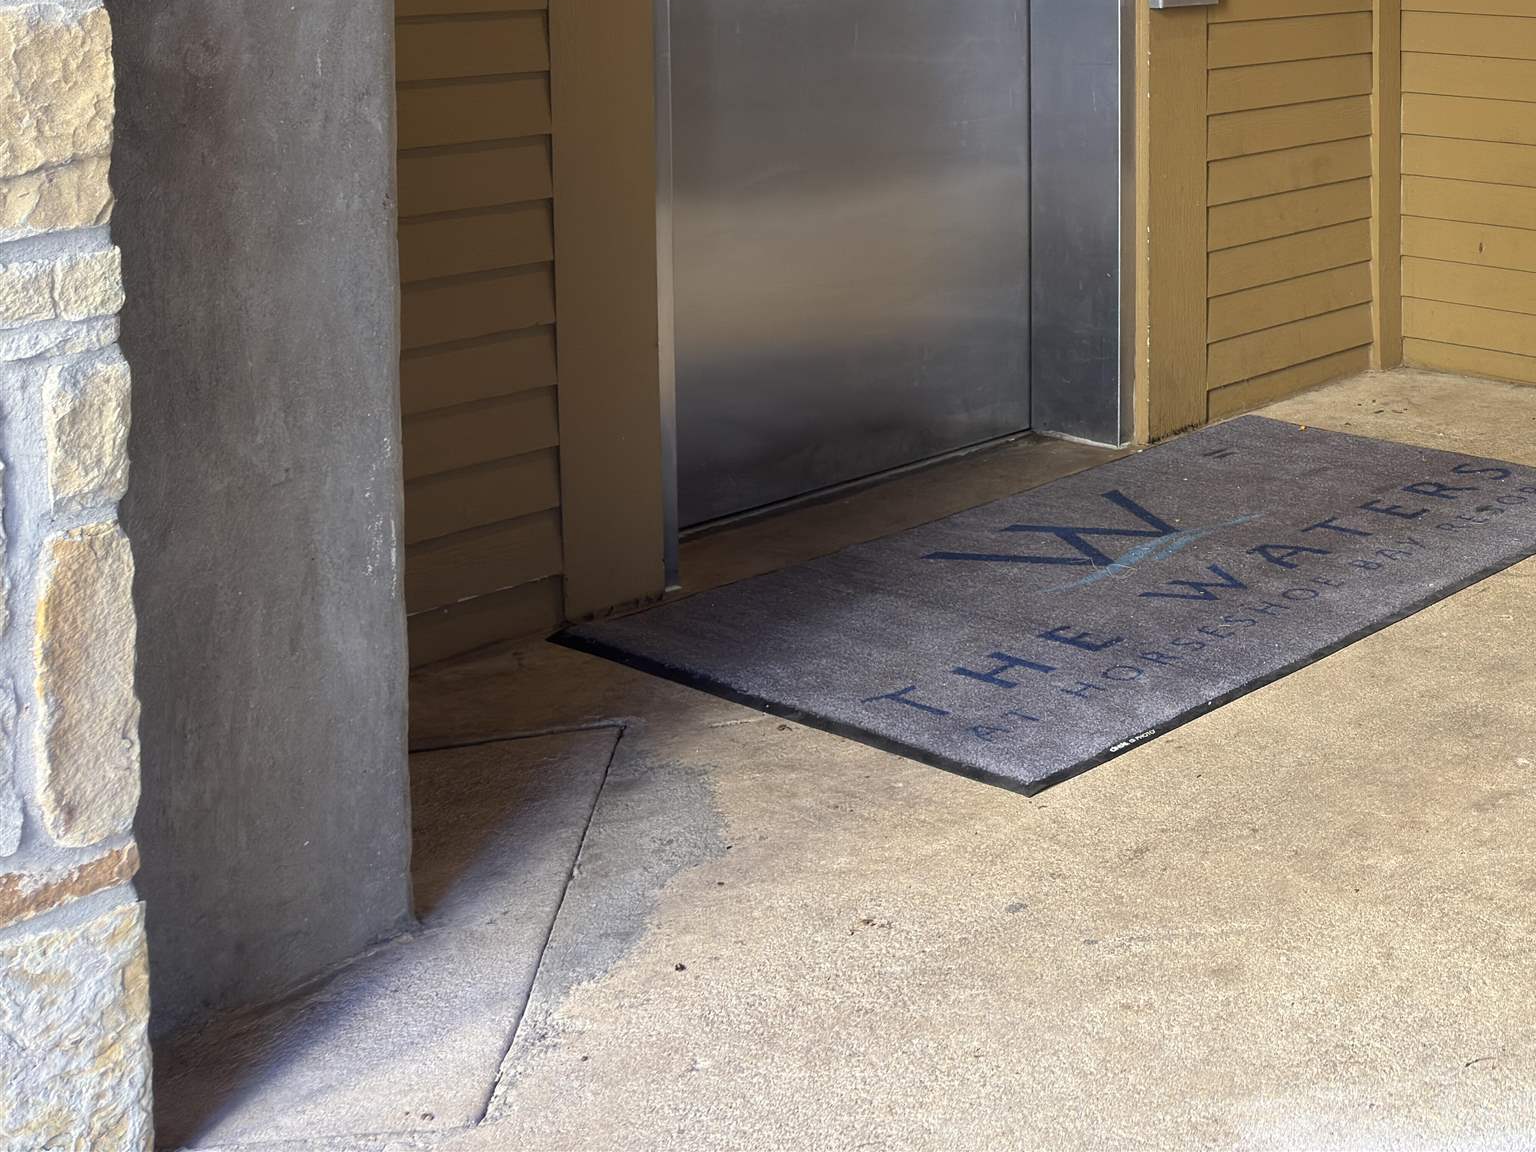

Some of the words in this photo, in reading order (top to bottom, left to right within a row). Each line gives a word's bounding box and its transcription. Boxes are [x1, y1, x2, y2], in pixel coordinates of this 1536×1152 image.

[861, 625, 1126, 716] THE
[1138, 462, 1511, 601] WATERS
[966, 708, 1040, 742] AT
[1059, 574, 1344, 699] HORSESHOE
[1351, 537, 1426, 571] BAY
